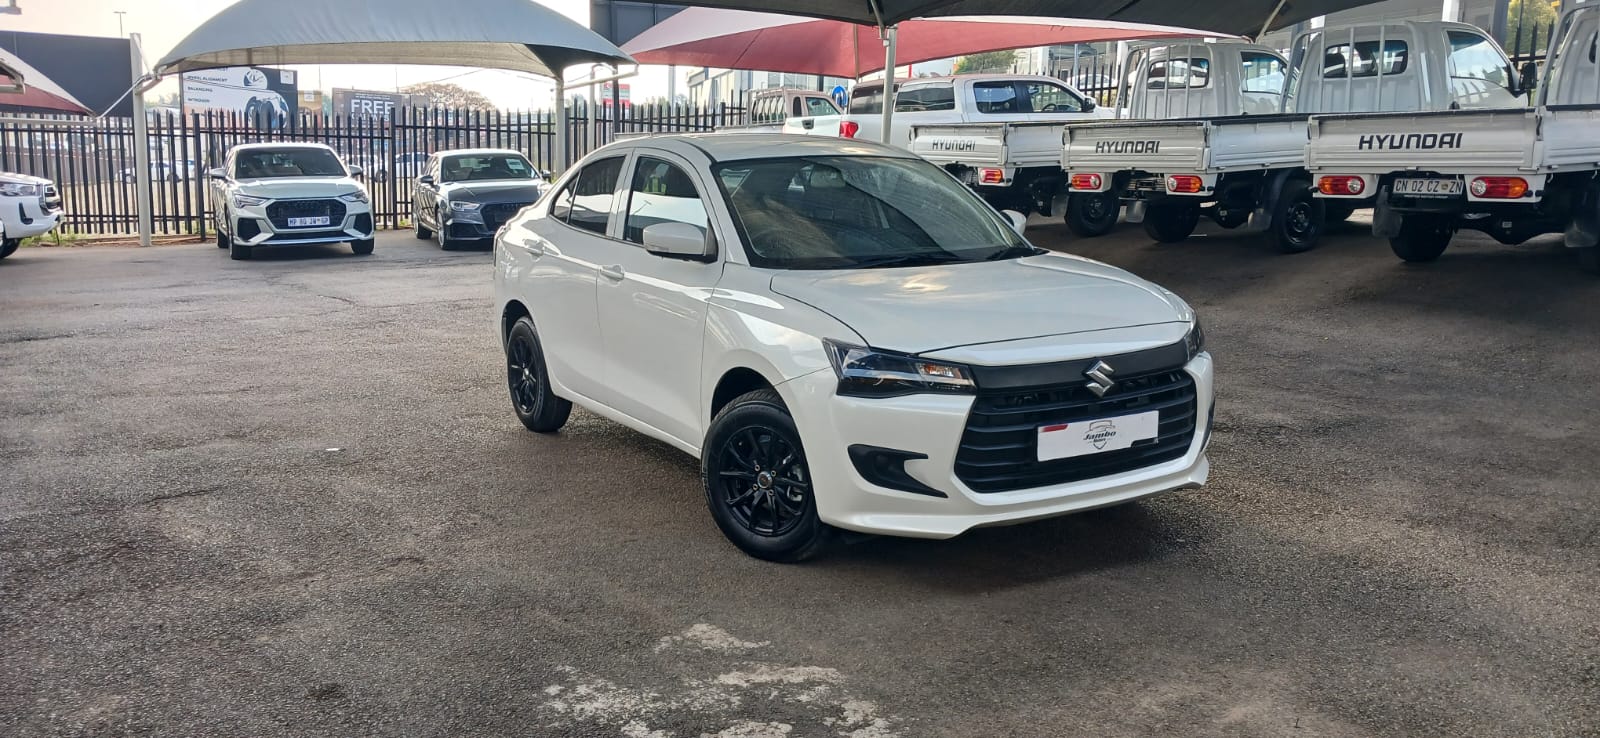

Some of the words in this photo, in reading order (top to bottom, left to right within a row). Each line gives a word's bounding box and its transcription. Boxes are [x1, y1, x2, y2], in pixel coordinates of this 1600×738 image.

[351, 99, 394, 114] FREE
[932, 139, 976, 150] HYUNDAI
[1096, 140, 1160, 154] HYUNDAI
[1359, 133, 1463, 150] HYUNDAI
[1396, 180, 1408, 192] CN
[1412, 180, 1424, 192] 02
[1427, 181, 1440, 192] CZ
[1449, 182, 1462, 192] ZN
[1083, 430, 1116, 440] Jambo
